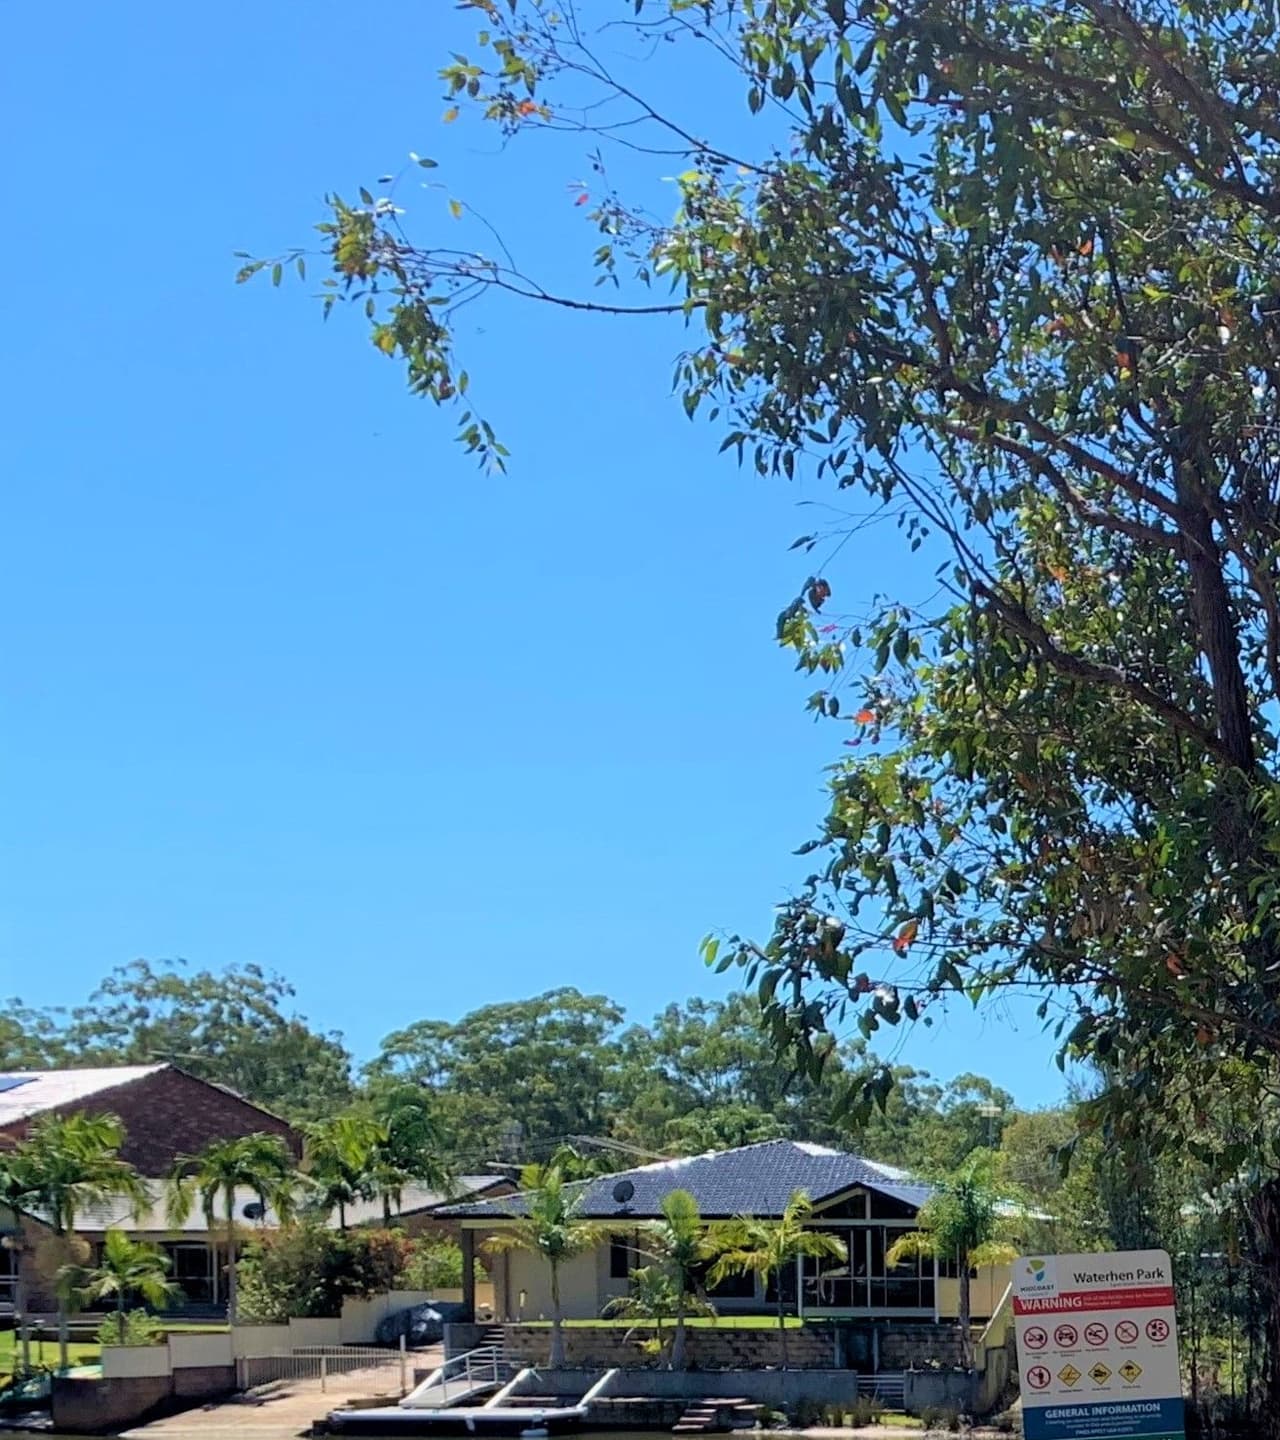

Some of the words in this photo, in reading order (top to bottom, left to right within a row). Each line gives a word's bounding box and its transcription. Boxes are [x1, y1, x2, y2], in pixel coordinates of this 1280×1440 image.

[1073, 1270, 1134, 1283] Waterhen
[1136, 1268, 1165, 1281] Park
[1020, 1296, 1082, 1310] WARNING
[1045, 1407, 1090, 1419] GENERAL
[1092, 1403, 1161, 1416] INFORMATION
